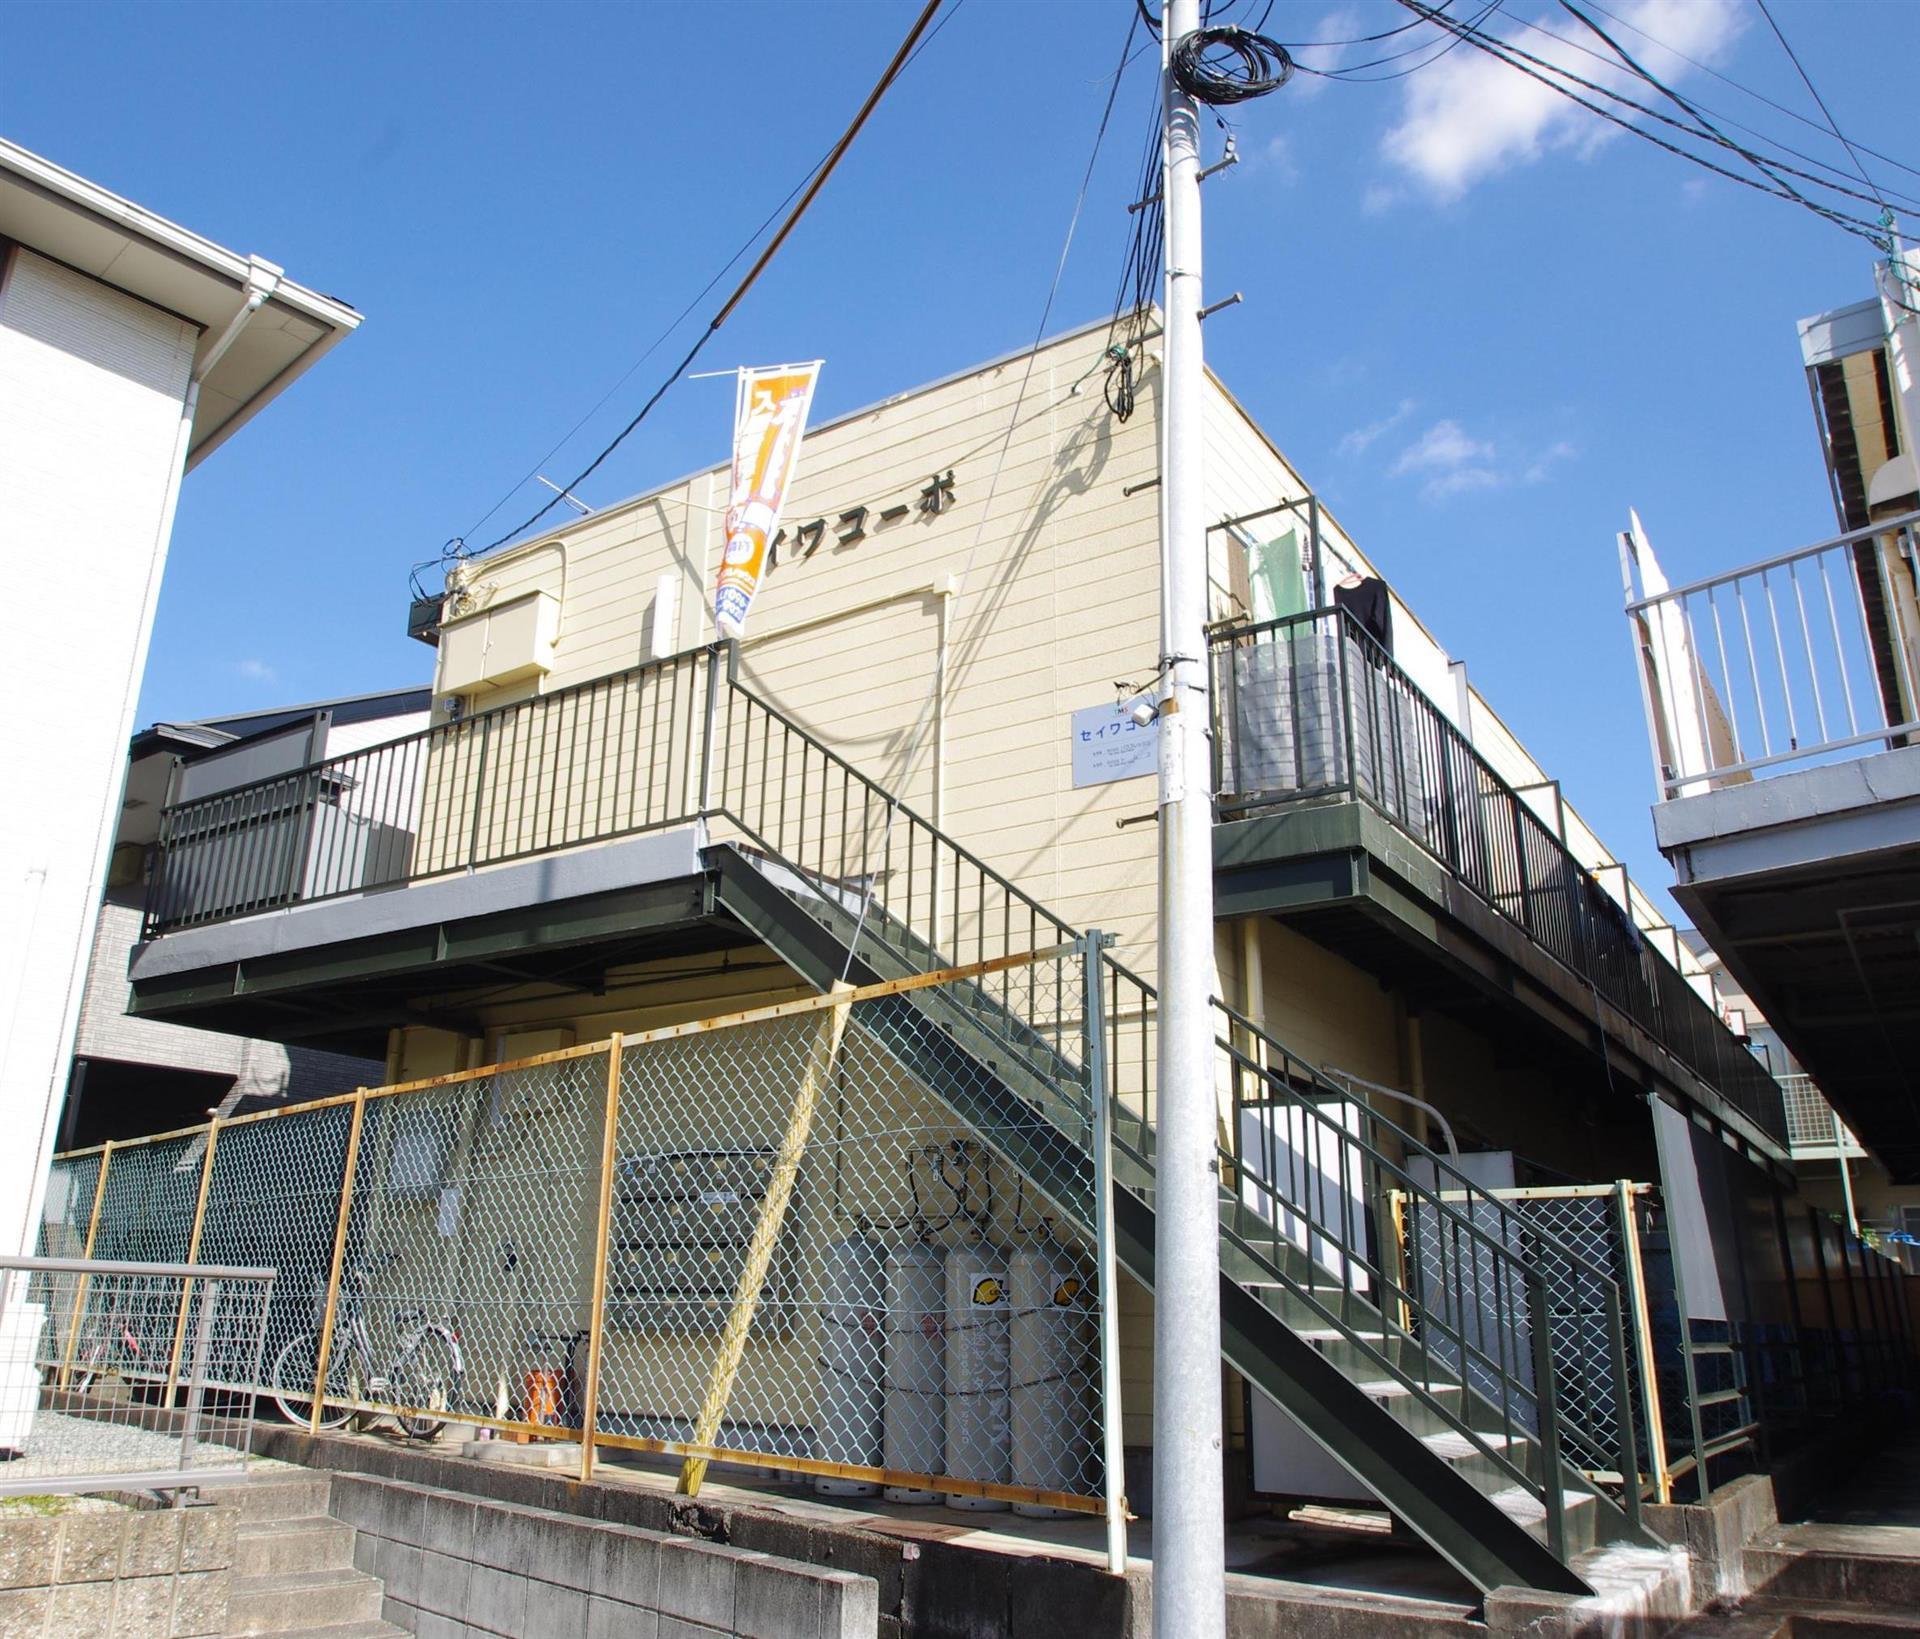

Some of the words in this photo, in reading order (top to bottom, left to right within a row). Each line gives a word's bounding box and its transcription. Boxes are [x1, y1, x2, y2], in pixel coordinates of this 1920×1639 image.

[767, 470, 956, 566] イワコーポ
[1080, 718, 1158, 741] セイワコ
